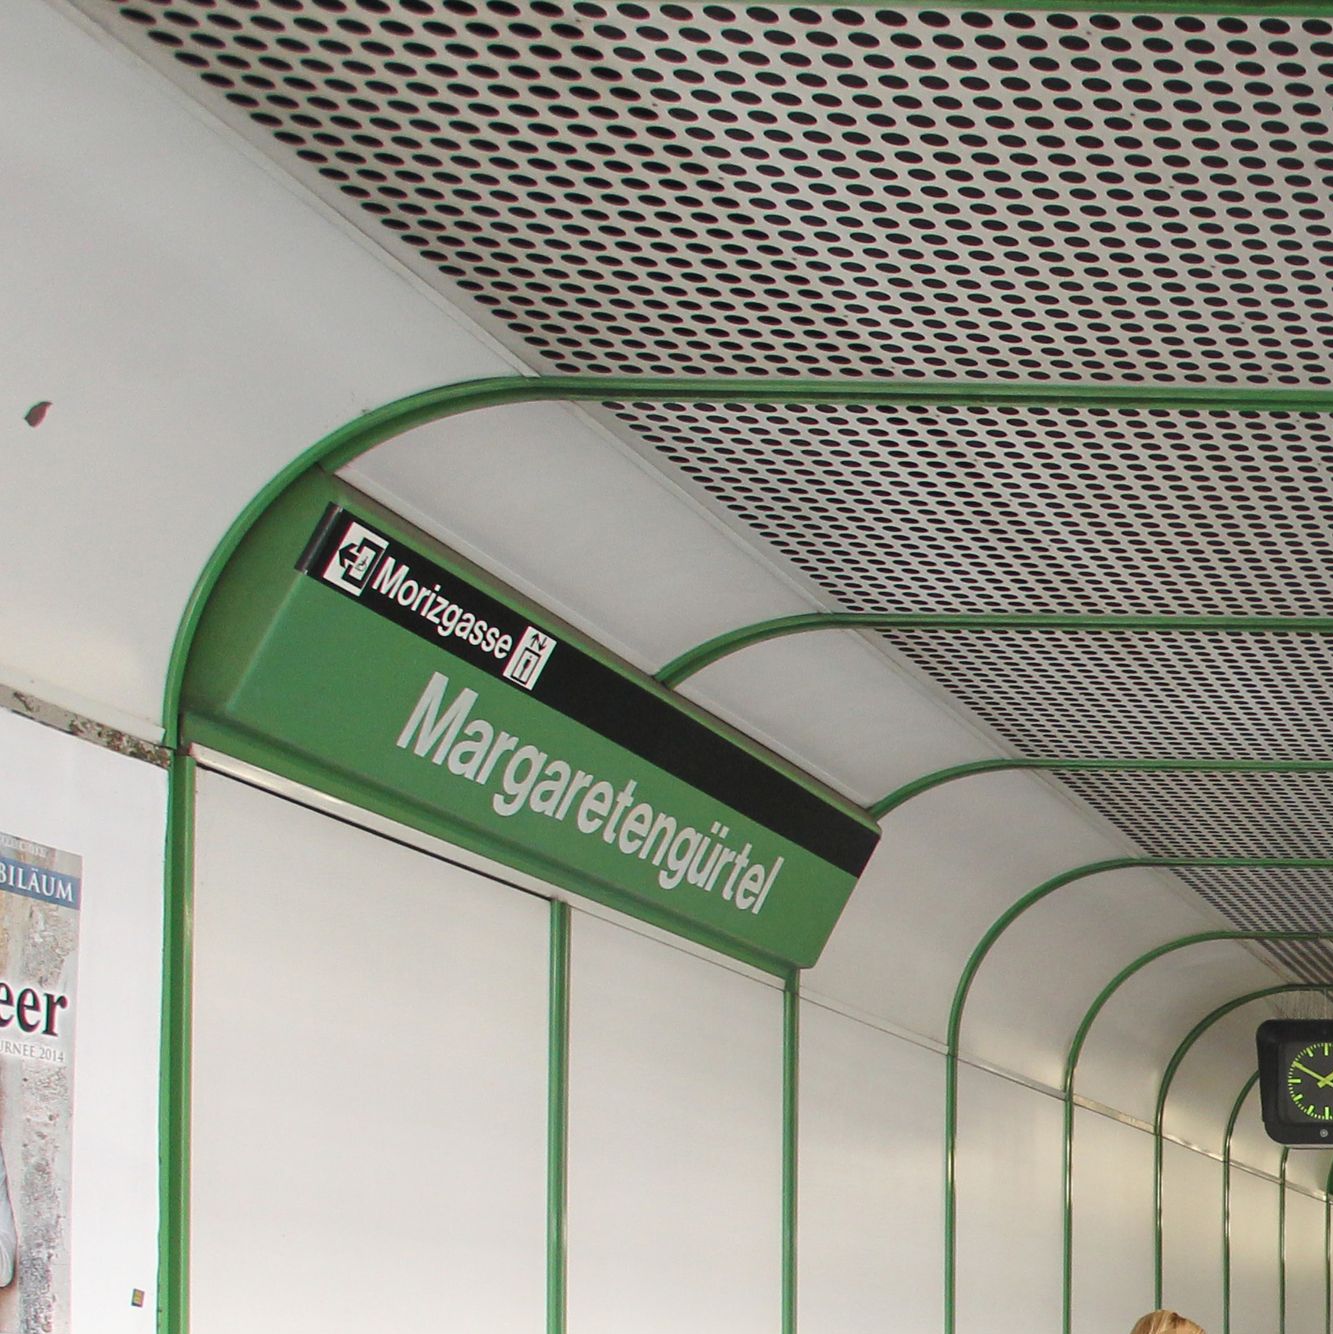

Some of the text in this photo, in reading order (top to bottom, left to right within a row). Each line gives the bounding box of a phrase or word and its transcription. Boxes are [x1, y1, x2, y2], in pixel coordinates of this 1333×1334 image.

[372, 556, 512, 659] Morizgasse
[396, 671, 784, 914] Margaretengürtel
[0, 862, 73, 902] BILÄUM
[0, 982, 68, 1036] eer
[39, 1047, 64, 1062] 2014
